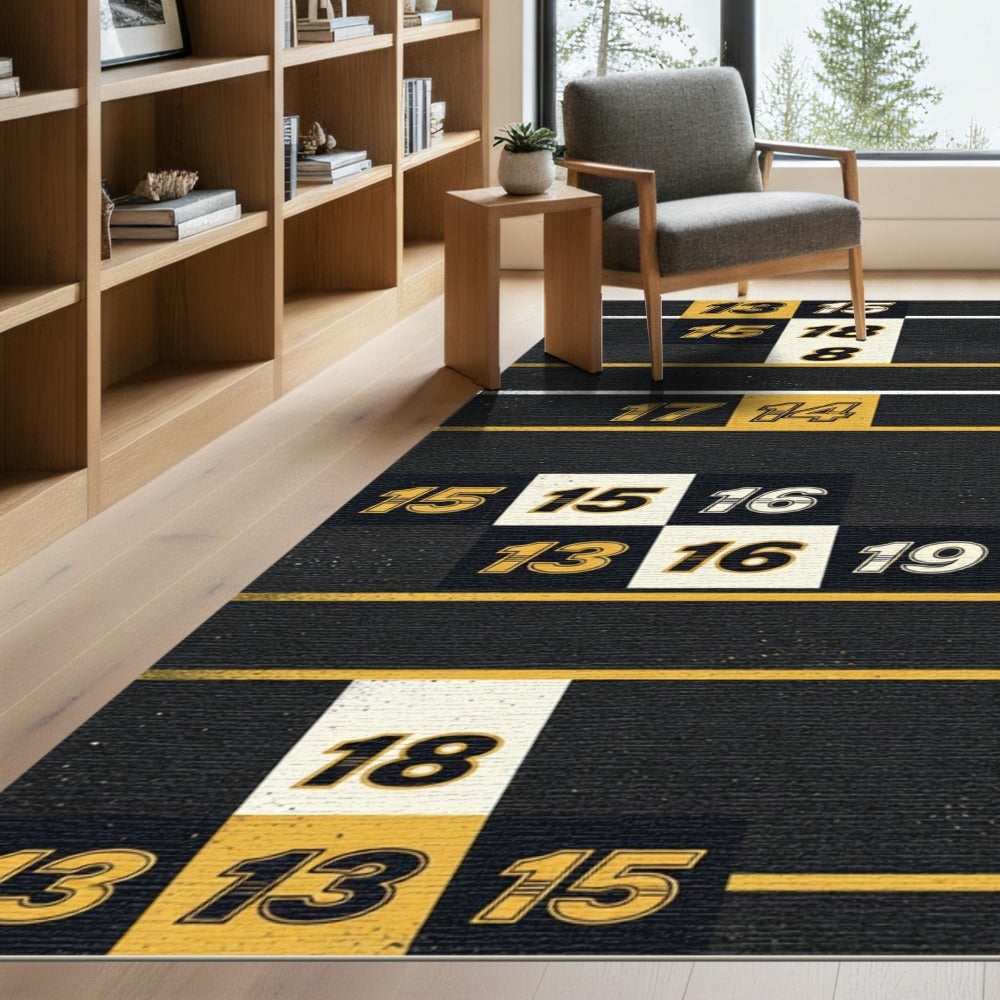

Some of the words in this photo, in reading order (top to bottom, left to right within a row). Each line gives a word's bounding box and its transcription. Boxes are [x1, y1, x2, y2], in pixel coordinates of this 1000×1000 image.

[698, 302, 787, 314] 13
[679, 324, 775, 339] 15
[800, 347, 863, 361] 8
[609, 402, 727, 421] 17
[749, 402, 861, 422] 14
[358, 486, 507, 514] 15
[527, 486, 668, 513] 15
[699, 486, 828, 514] 16
[477, 540, 630, 575] 13
[660, 540, 808, 574] 16
[852, 540, 990, 575] 19
[291, 731, 505, 789] 18
[173, 847, 431, 925] 13
[469, 848, 708, 926] 15
